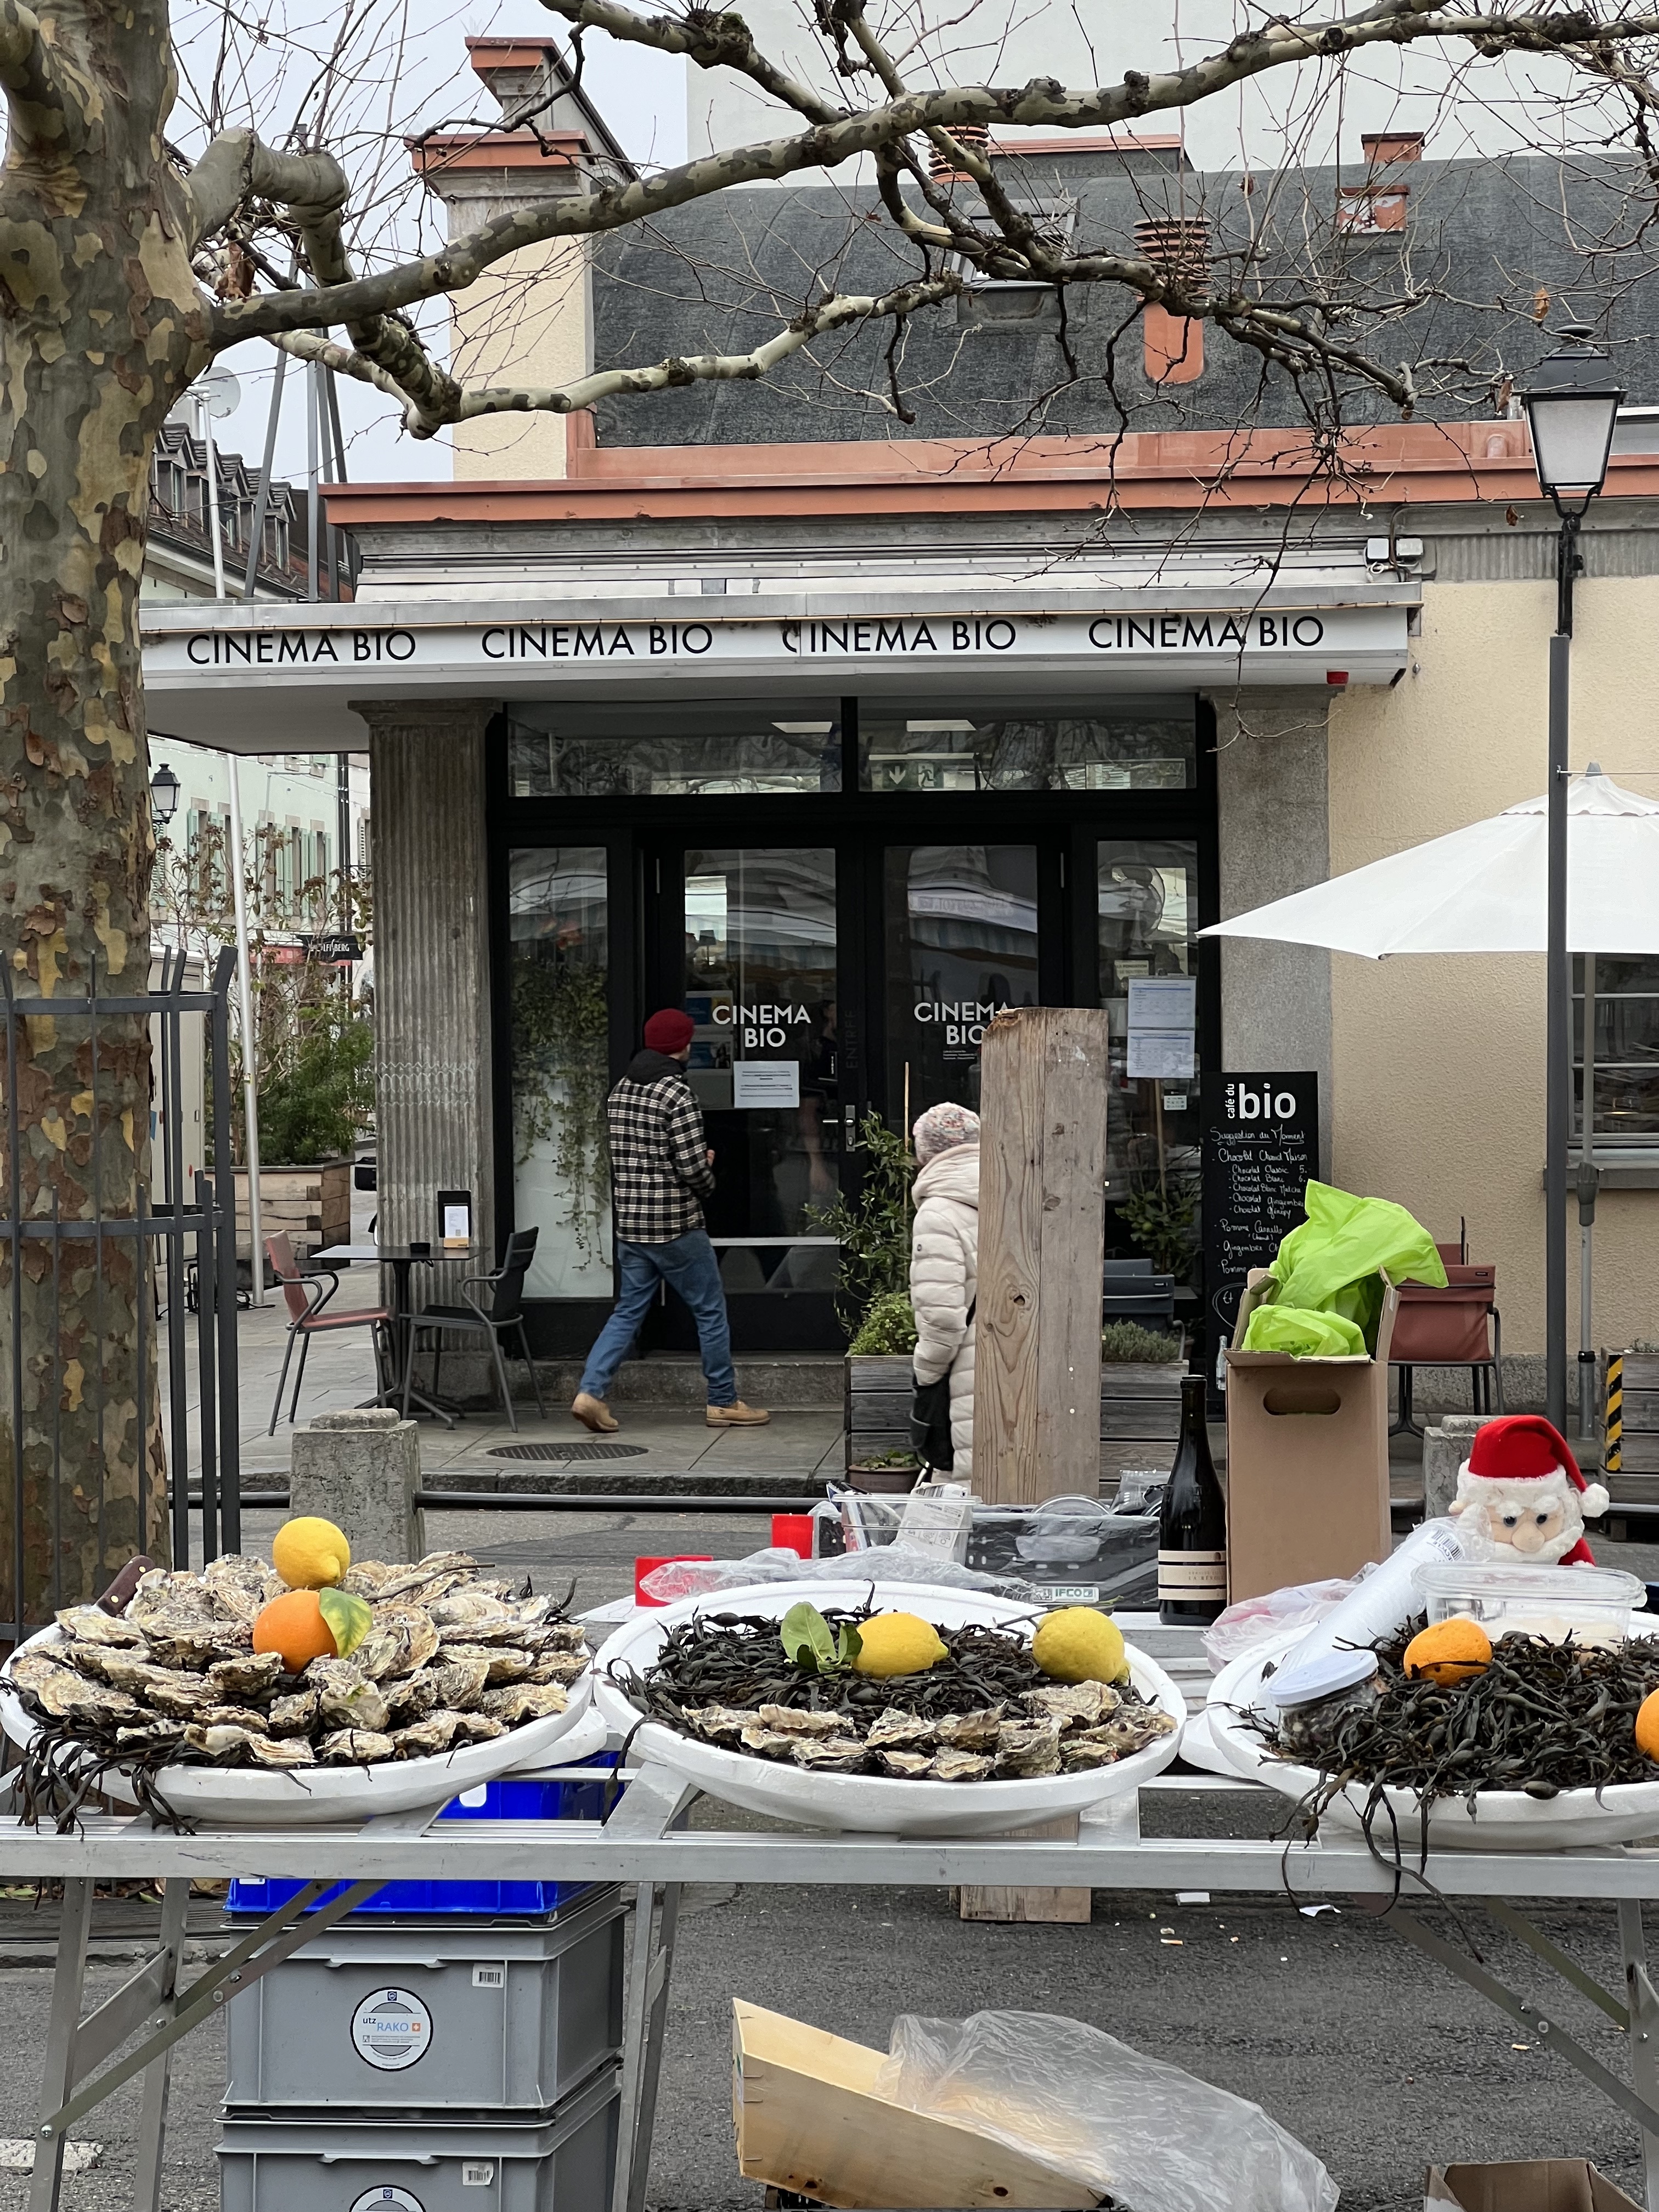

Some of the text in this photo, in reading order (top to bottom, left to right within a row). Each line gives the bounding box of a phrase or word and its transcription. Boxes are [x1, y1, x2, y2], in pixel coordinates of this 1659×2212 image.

[481, 623, 713, 658] CINEMA BIO
[782, 619, 1016, 653] CINEMA BIO
[1089, 616, 1324, 648] CINEMA BIO
[188, 630, 416, 664] CINEMA BIO
[712, 1005, 811, 1025] CINEMA
[744, 1028, 786, 1047] BIO
[946, 1025, 984, 1045] BIO
[1225, 1084, 1235, 1119] café du
[1239, 1083, 1296, 1119] bio
[1210, 1127, 1255, 1146] Suggestion
[1271, 1124, 1306, 1146] Moment
[1221, 1259, 1247, 1274] Pomme
[1055, 1588, 1082, 1597] IFCO
[376, 2022, 409, 2032] RAKO
